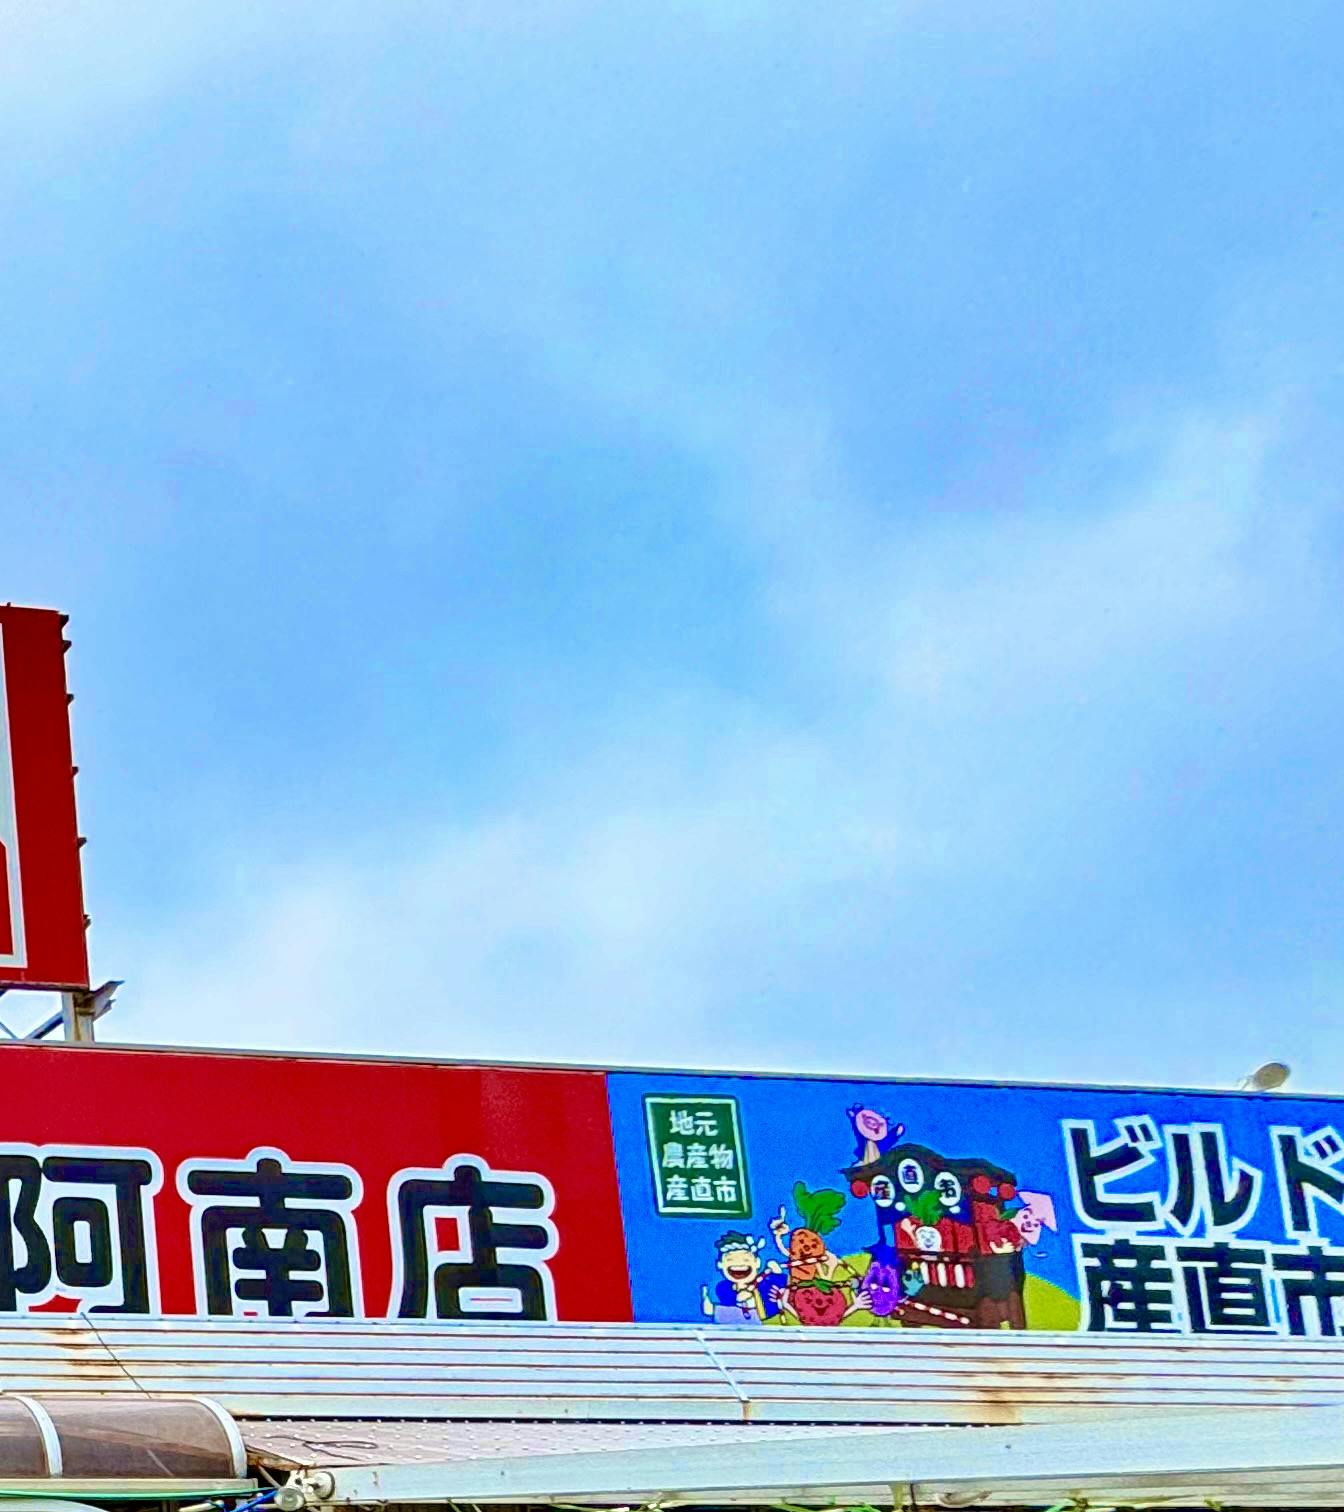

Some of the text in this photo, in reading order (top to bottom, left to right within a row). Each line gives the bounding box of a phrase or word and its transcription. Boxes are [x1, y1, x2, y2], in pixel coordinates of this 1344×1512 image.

[669, 1109, 719, 1137] 地元
[662, 1142, 734, 1170] 農産物
[665, 1175, 737, 1203] 産直市
